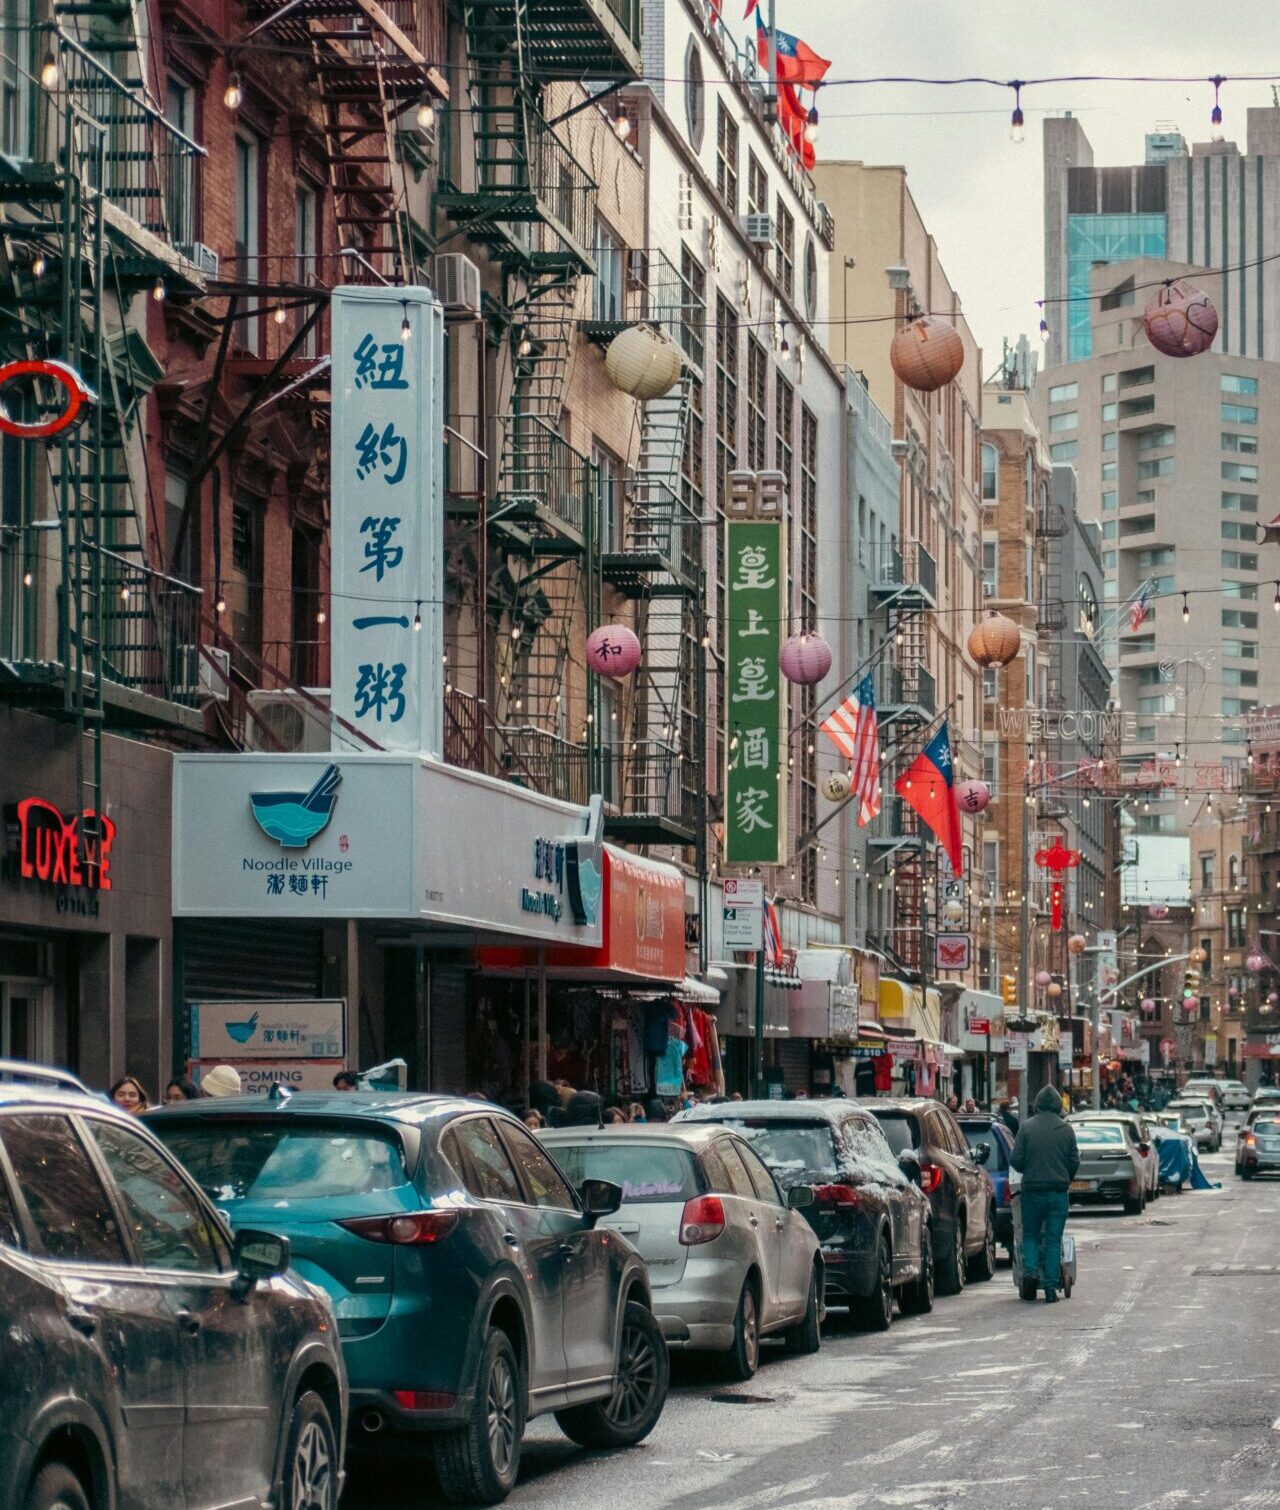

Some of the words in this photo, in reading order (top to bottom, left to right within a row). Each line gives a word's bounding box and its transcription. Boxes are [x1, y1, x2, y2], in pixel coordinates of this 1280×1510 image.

[726, 470, 786, 521] 66
[352, 333, 410, 722] 紐約第一粥
[594, 637, 623, 662] 和
[999, 708, 1138, 741] WELCOME
[243, 858, 298, 871] Noodle
[301, 858, 353, 874] Village
[266, 874, 329, 900] 粥麵軒
[727, 909, 734, 920] 2
[240, 1070, 303, 1082] COMING
